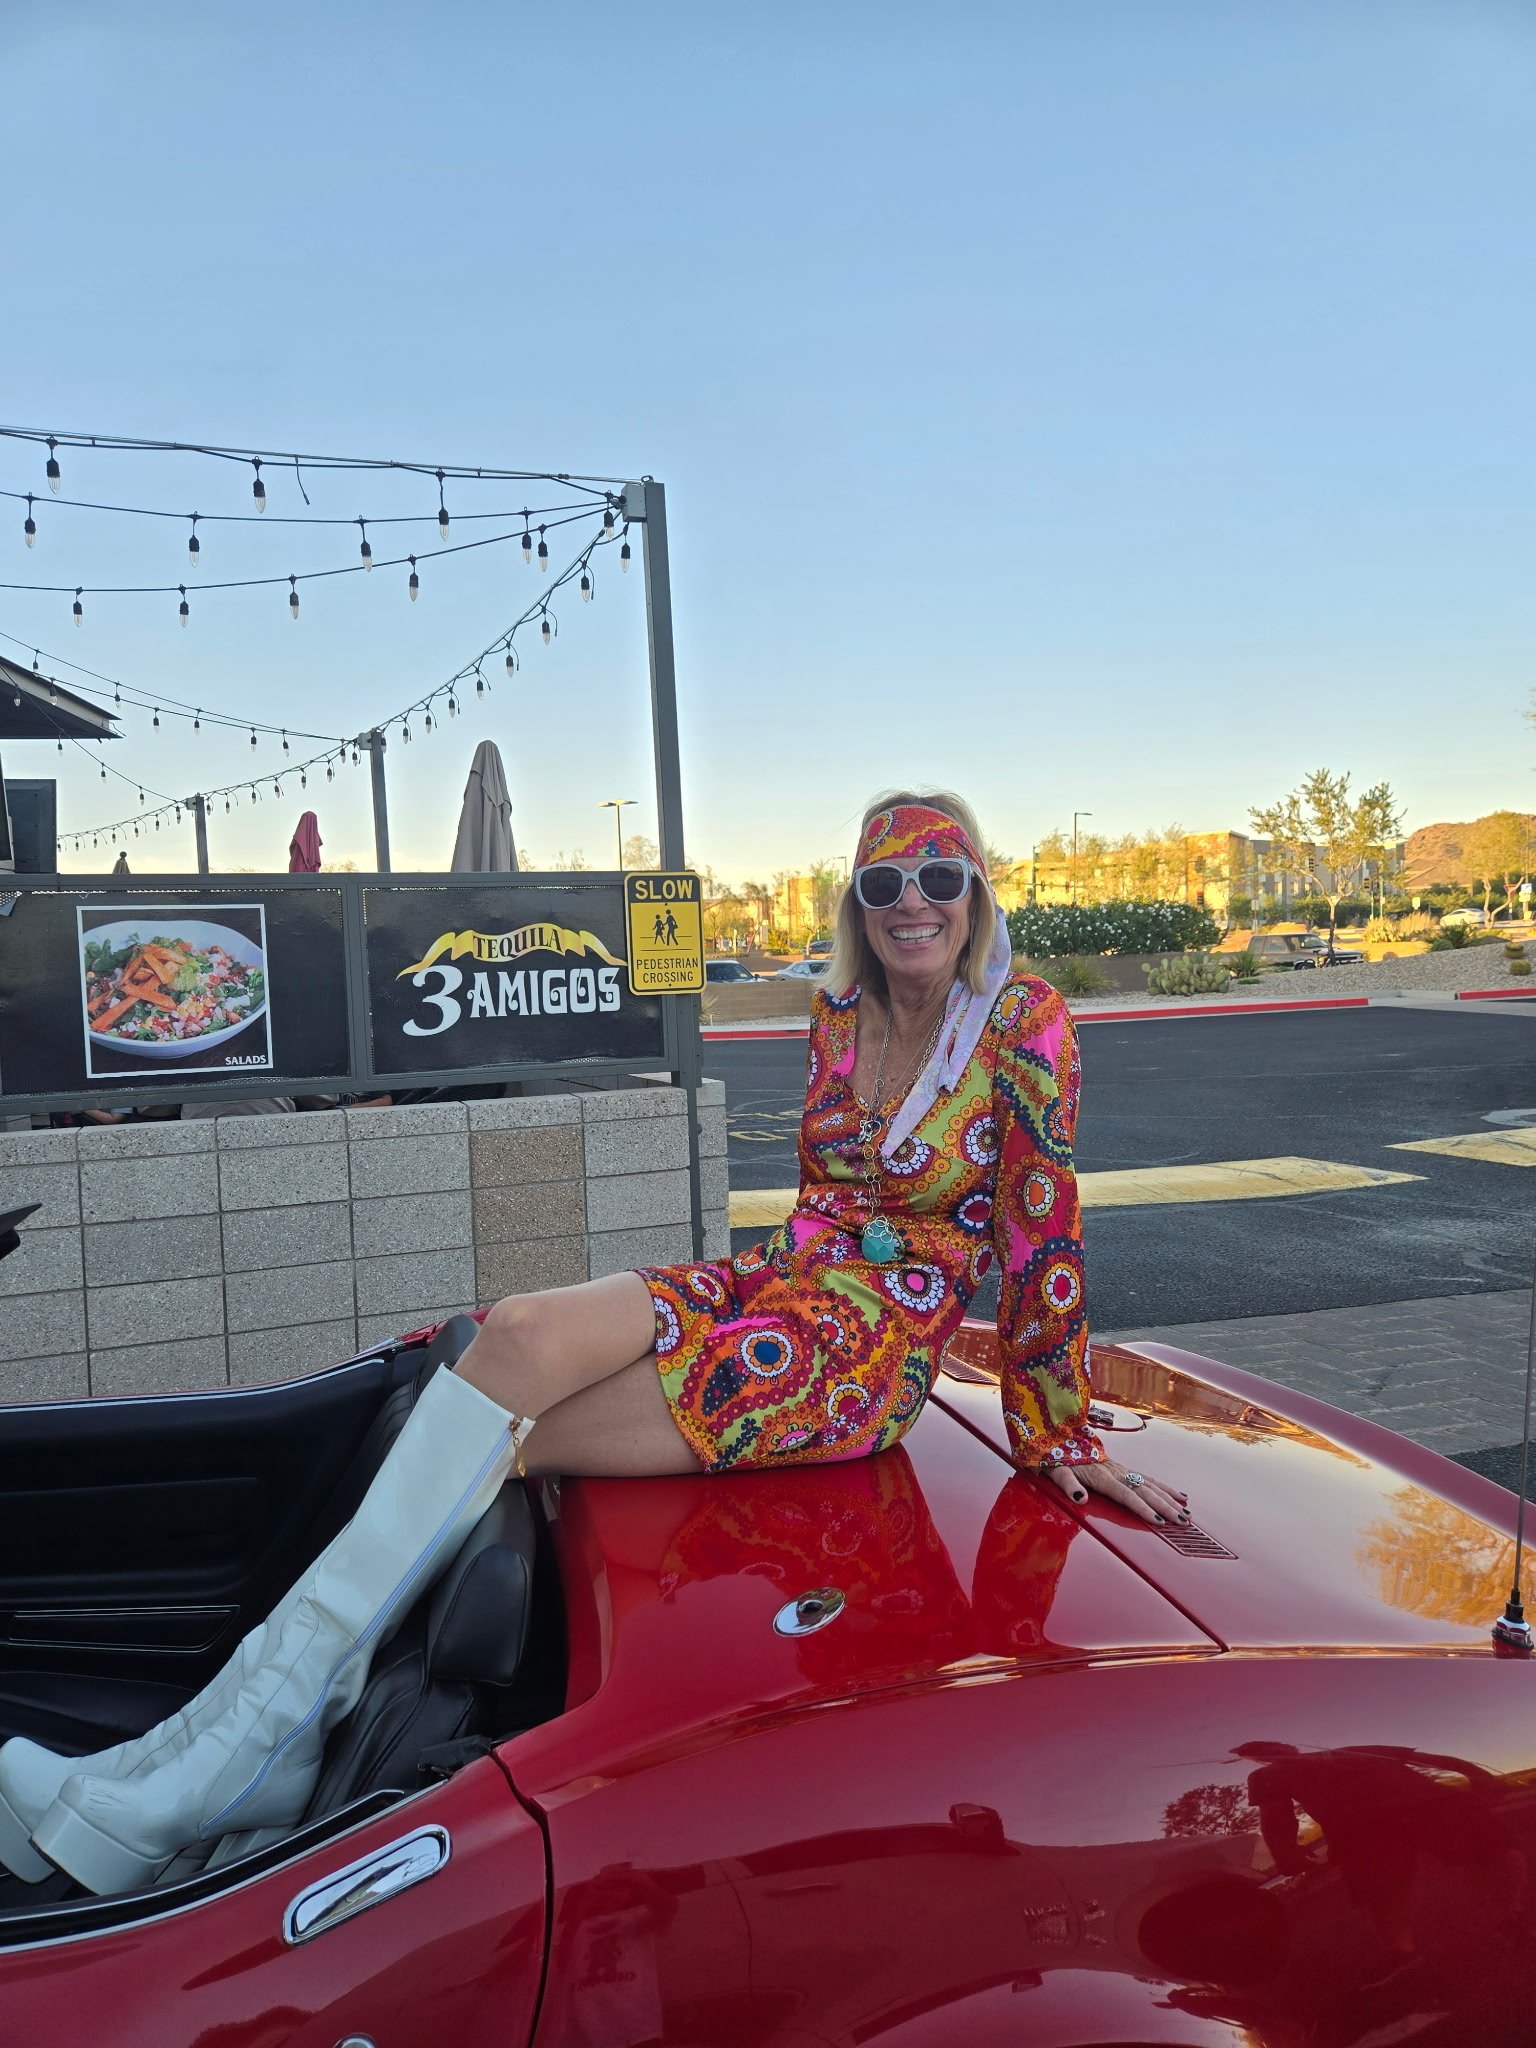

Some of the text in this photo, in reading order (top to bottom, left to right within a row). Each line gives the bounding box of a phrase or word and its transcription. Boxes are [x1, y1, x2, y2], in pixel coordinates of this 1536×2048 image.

[635, 879, 693, 900] SLOW
[473, 927, 563, 959] TEQUILA
[636, 957, 699, 970] PEDESTRIAN
[643, 971, 694, 984] CROSSING
[402, 965, 621, 1037] 3 AMIGOS
[225, 1054, 267, 1065] SALADS
